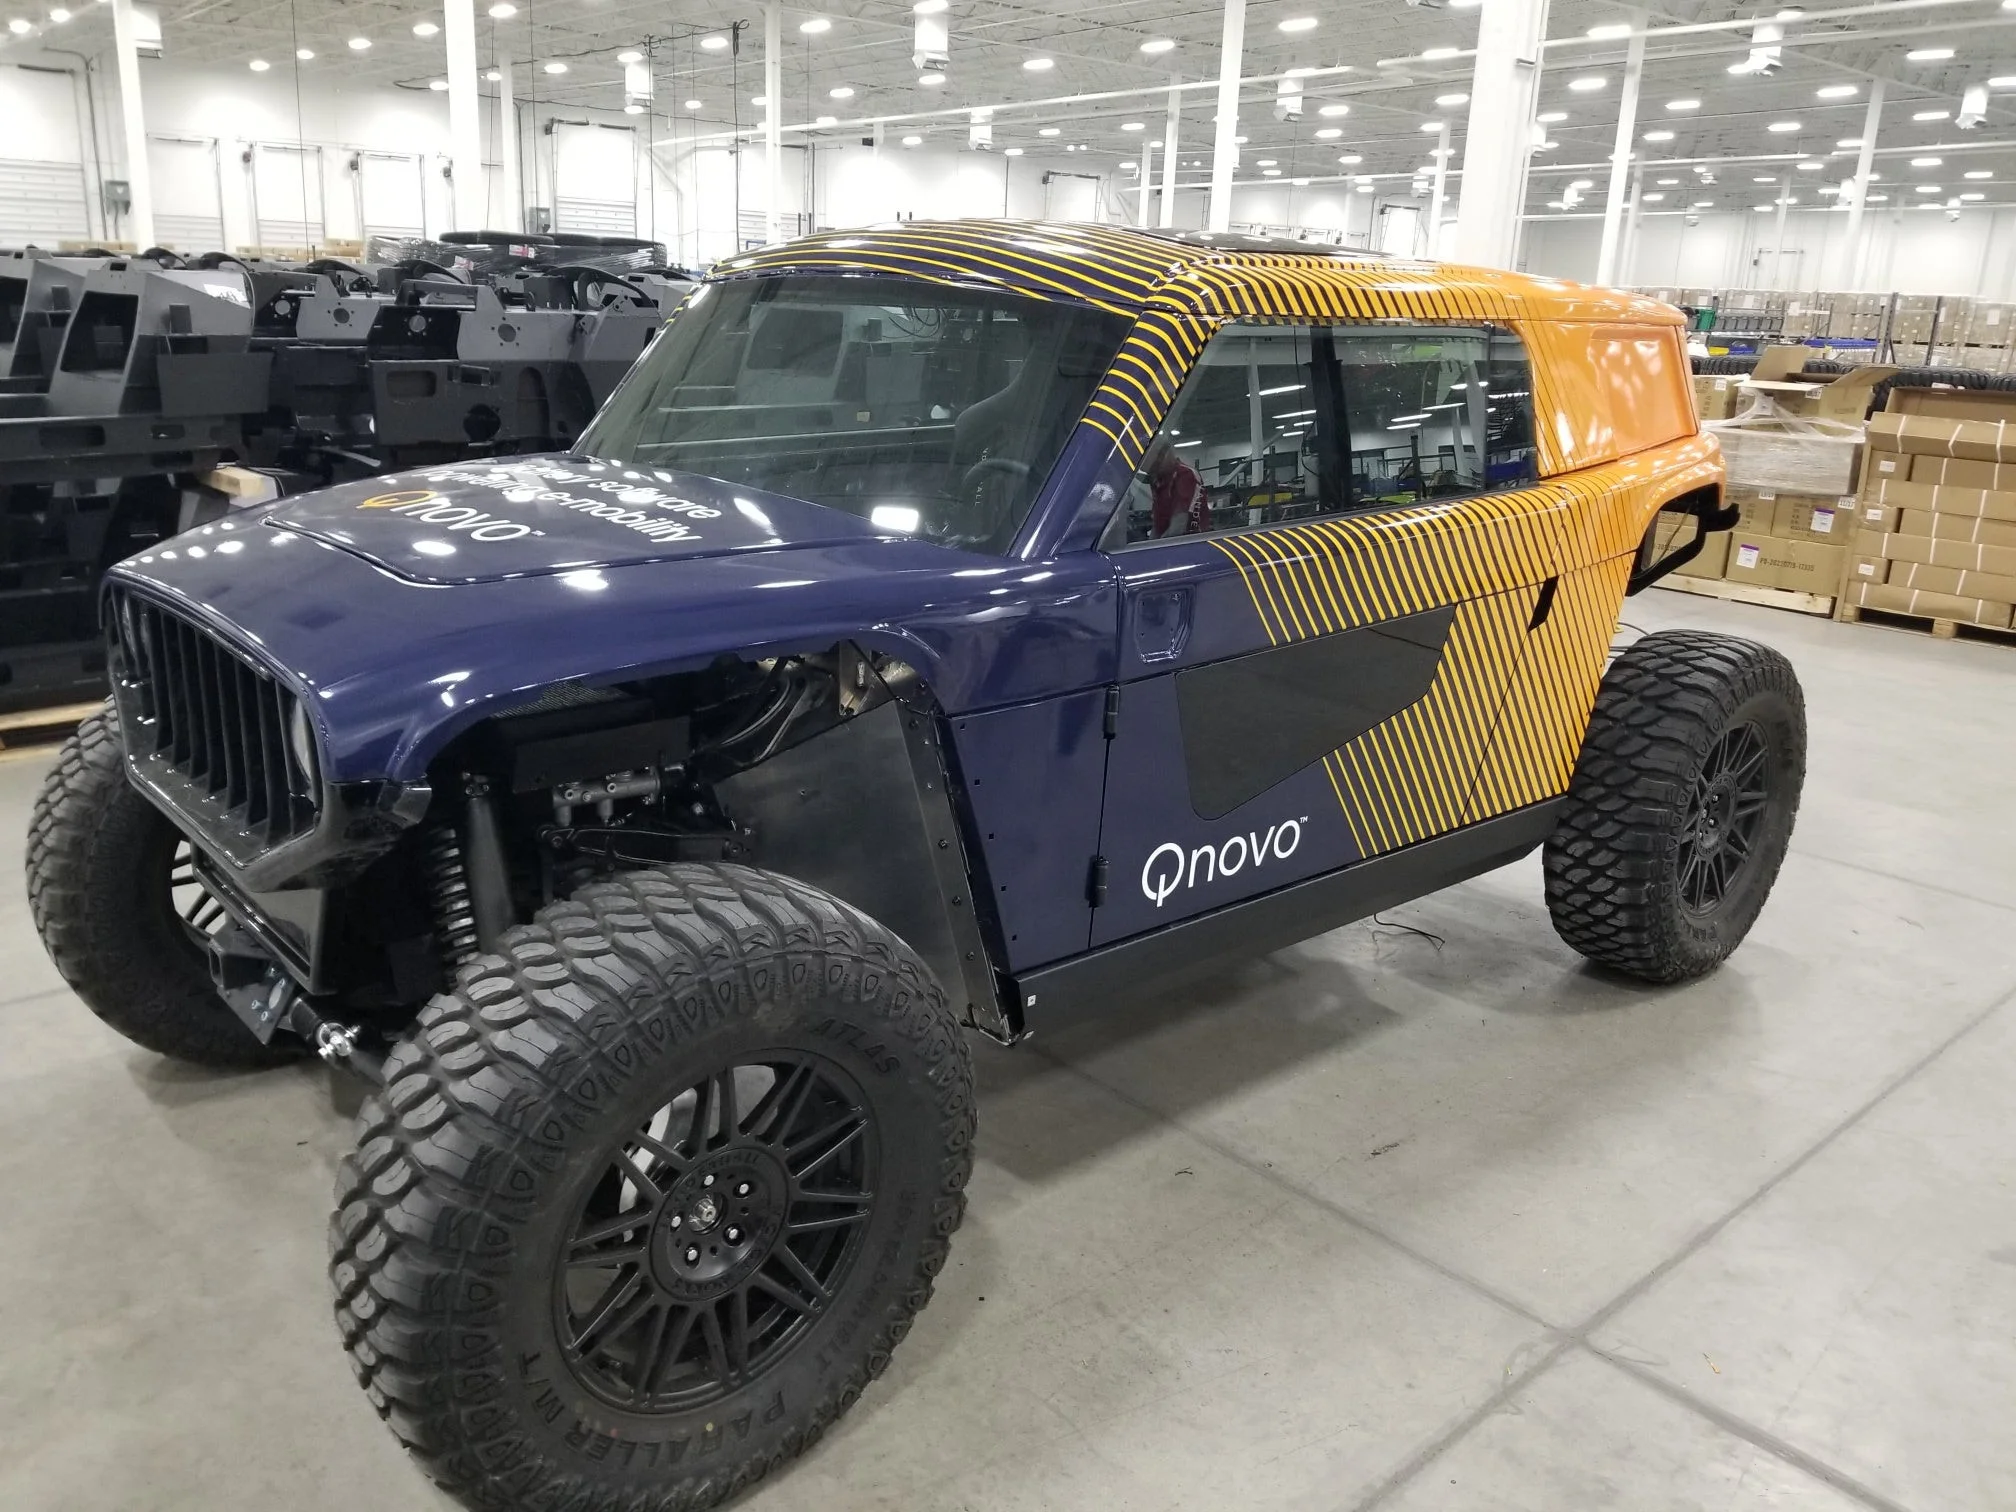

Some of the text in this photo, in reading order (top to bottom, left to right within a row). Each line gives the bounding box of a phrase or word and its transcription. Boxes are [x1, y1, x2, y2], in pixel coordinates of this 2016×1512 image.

[538, 491, 703, 543] e-mobility
[1141, 819, 1301, 908] Qnovo
[808, 1016, 902, 1075] ATLAS
[562, 1390, 787, 1468] PARALLER
